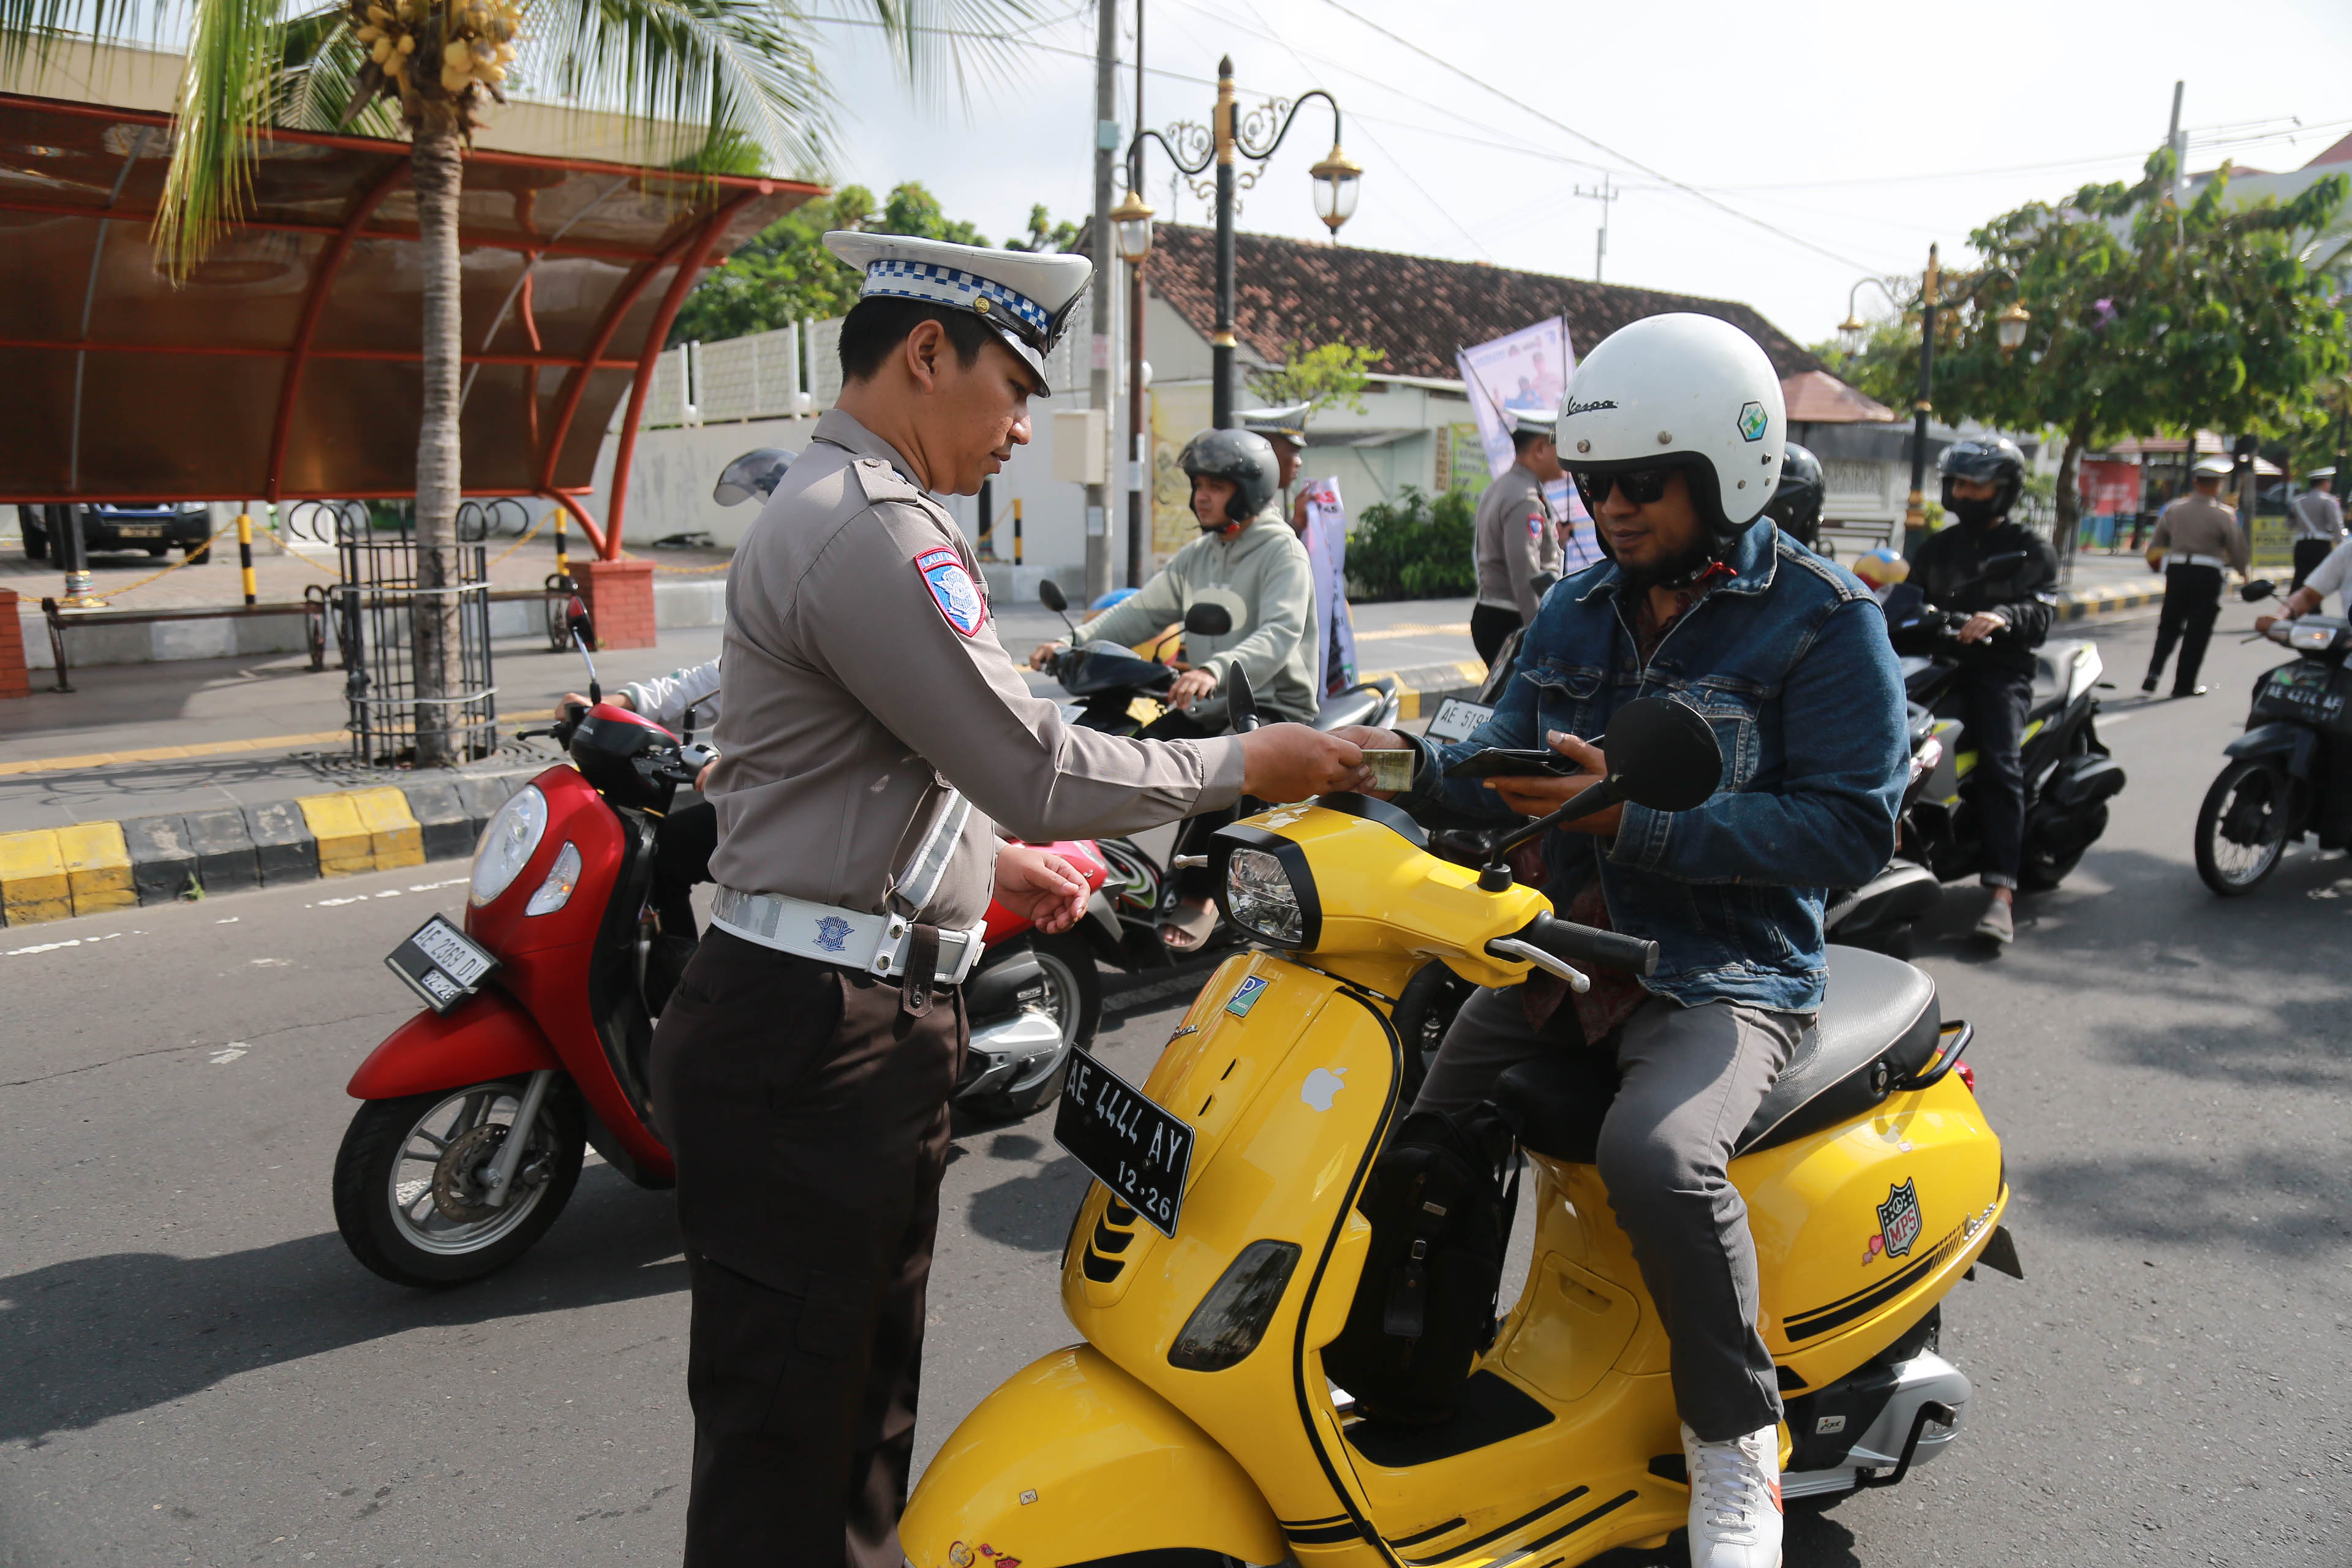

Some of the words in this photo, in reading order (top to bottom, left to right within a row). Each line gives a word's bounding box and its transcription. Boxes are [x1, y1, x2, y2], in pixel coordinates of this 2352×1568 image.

[1567, 396, 1619, 417] Vespa
[922, 552, 944, 566] LALU
[1441, 706, 1459, 724] AE
[1461, 710, 1490, 729] 519
[416, 926, 441, 948] AE
[431, 938, 466, 968] 2369
[457, 957, 484, 982] DV
[1234, 978, 1256, 998] P
[1066, 1059, 1091, 1106] AE
[1095, 1082, 1142, 1145] 4444
[1148, 1122, 1183, 1172] AY
[1888, 1208, 1917, 1248] MPS
